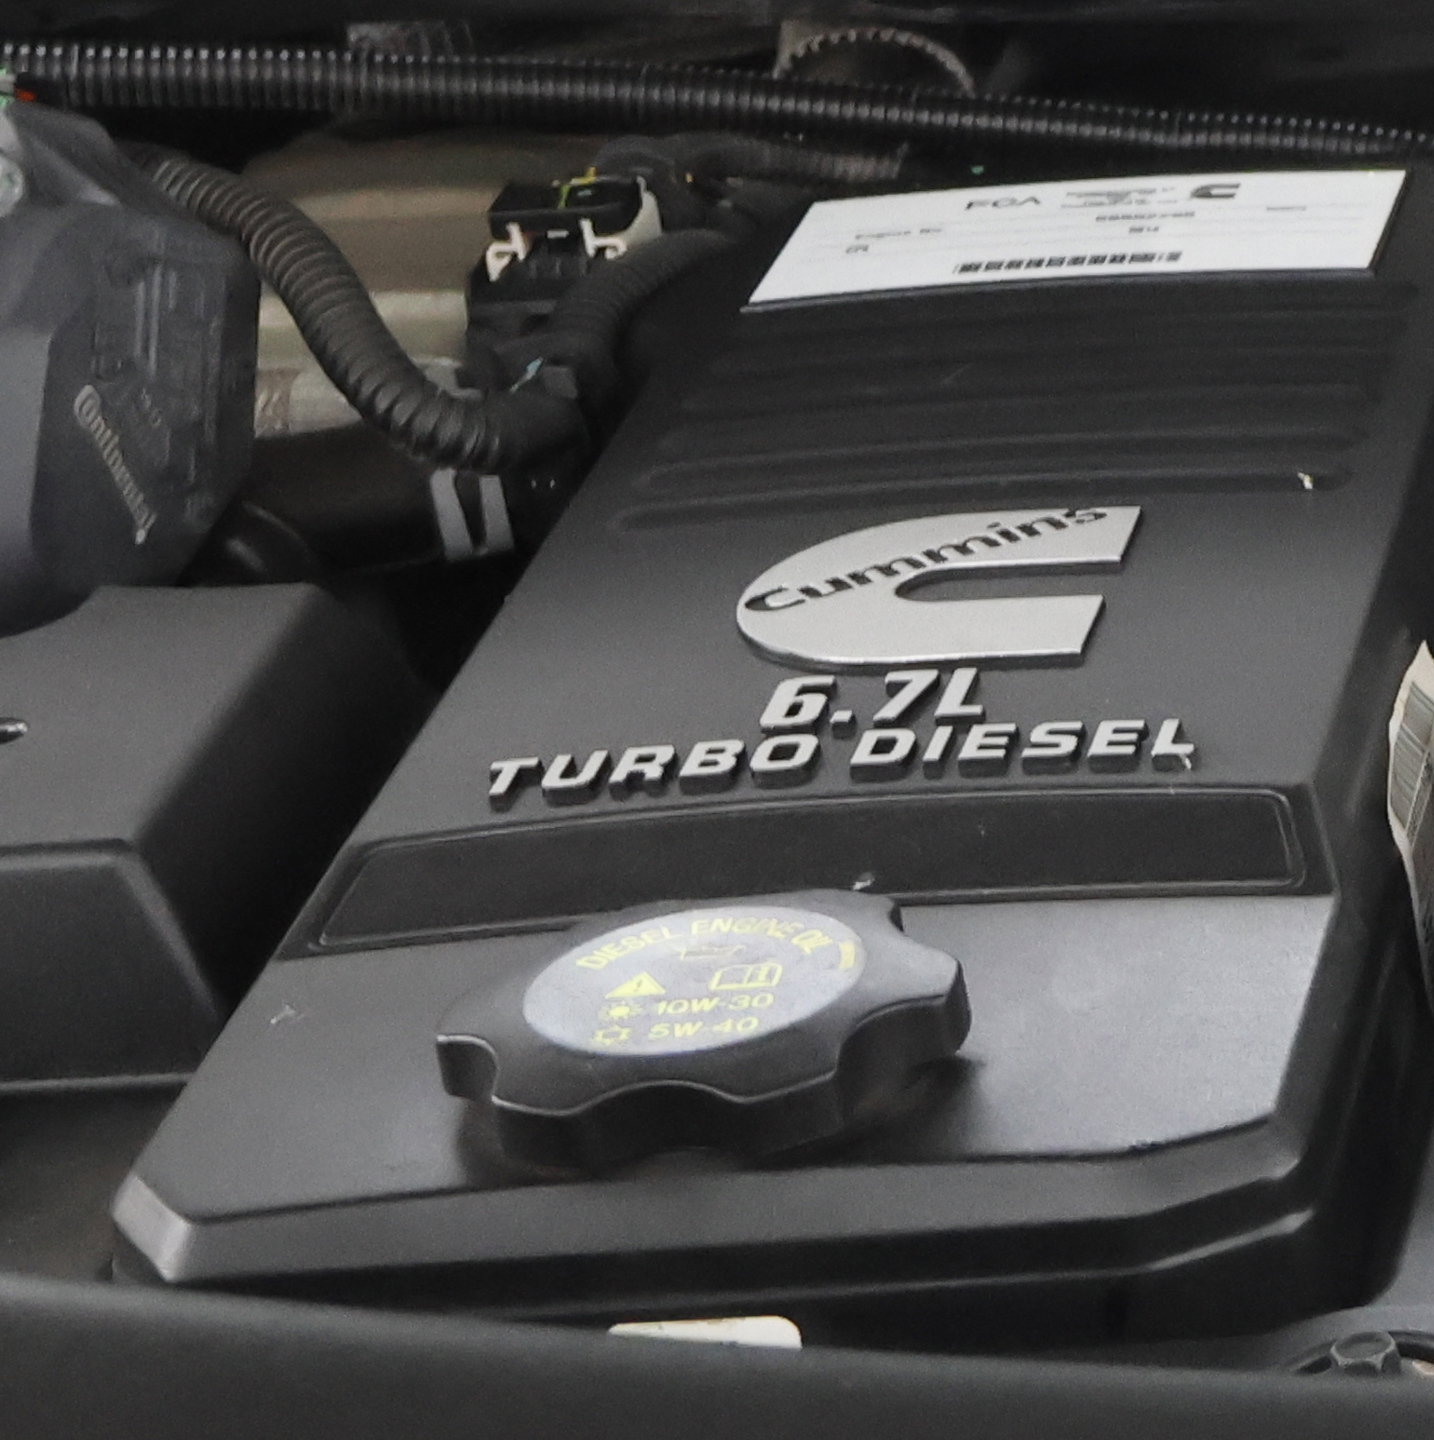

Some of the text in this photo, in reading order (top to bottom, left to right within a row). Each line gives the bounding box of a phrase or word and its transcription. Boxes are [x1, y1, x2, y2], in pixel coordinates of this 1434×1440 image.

[759, 666, 985, 733] 6.7L
[489, 718, 1195, 798] TURBO DIESEL
[576, 926, 684, 970] DIESEL
[690, 916, 805, 941] ENGINE
[647, 1016, 760, 1041] 5W-40
[656, 992, 775, 1016] 10W-30
